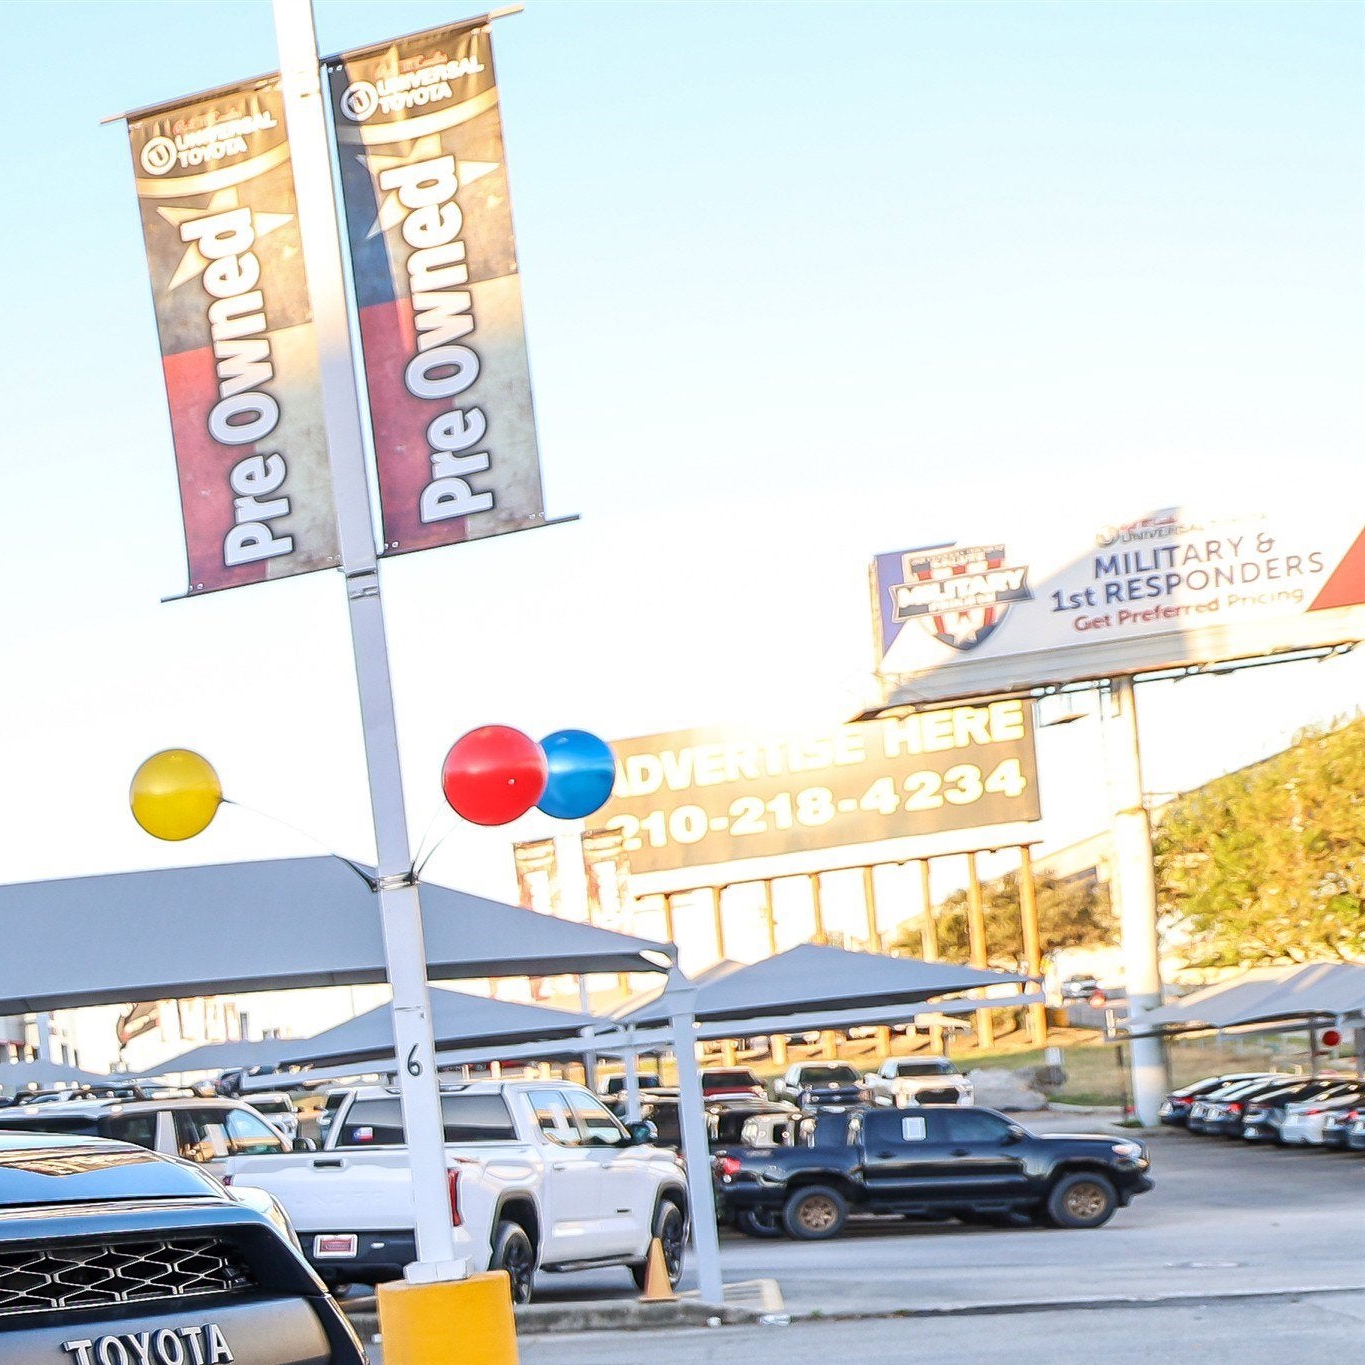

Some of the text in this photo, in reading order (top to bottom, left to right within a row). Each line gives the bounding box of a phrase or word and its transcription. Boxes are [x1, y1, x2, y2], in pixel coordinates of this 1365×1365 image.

[378, 82, 453, 114] TOYOTA
[177, 136, 248, 168] TOYOTA
[379, 153, 482, 400] Owned
[178, 205, 281, 446] Owned
[418, 407, 494, 524] Pre
[223, 451, 295, 567] Pre
[1050, 551, 1325, 613] 1st RESPONDERS
[1094, 531, 1276, 580] MILITARY &
[1073, 587, 1305, 632] Get Preferred Pricing
[883, 702, 1024, 758] HERE
[407, 1042, 423, 1077] 6
